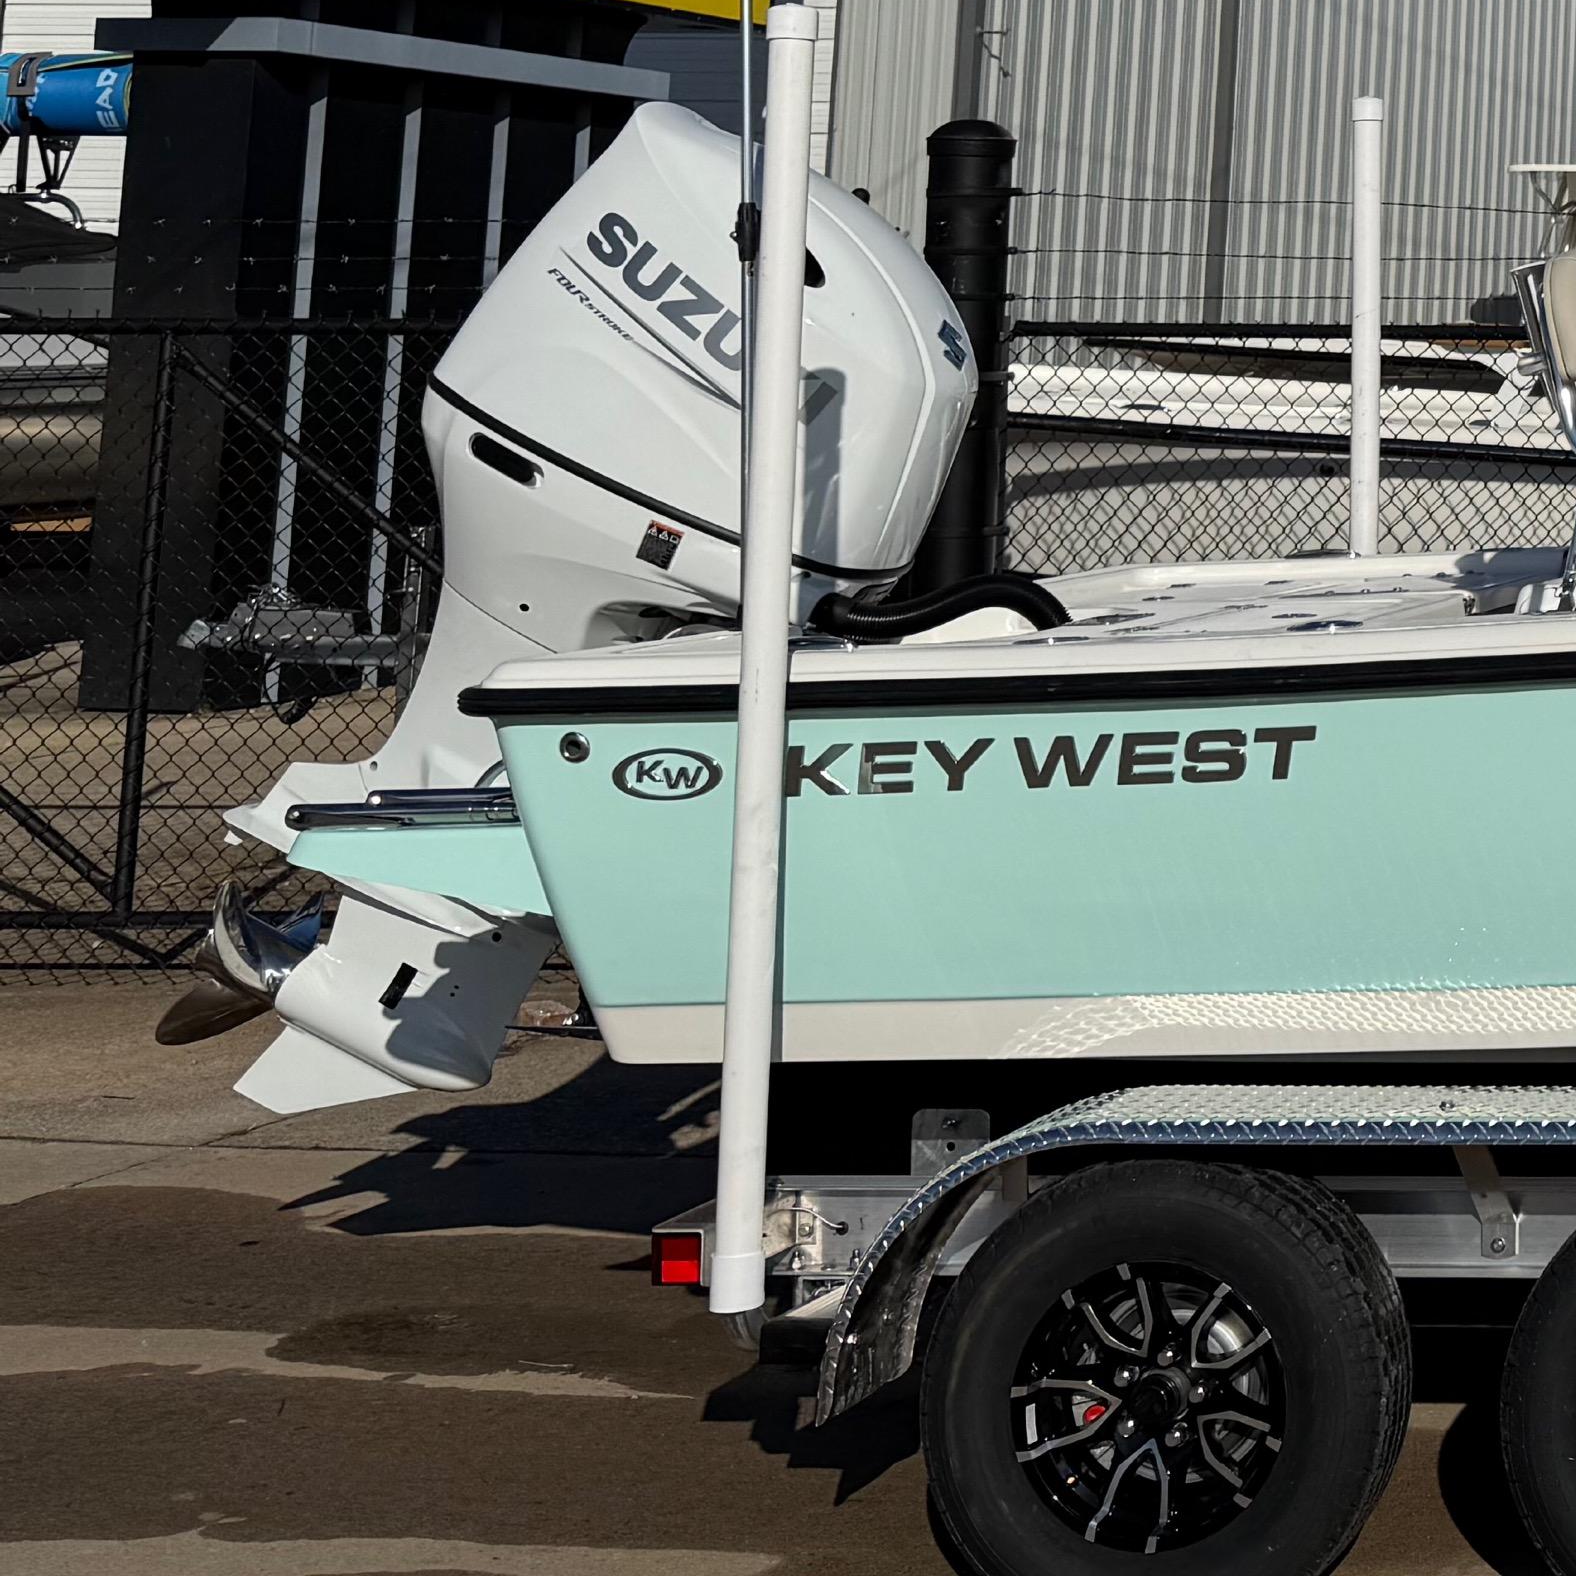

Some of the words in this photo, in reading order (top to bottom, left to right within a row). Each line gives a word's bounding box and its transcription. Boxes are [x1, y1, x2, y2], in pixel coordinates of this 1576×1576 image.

[635, 759, 704, 789] KW
[785, 738, 995, 797] KEY
[1013, 725, 1317, 789] WEST
